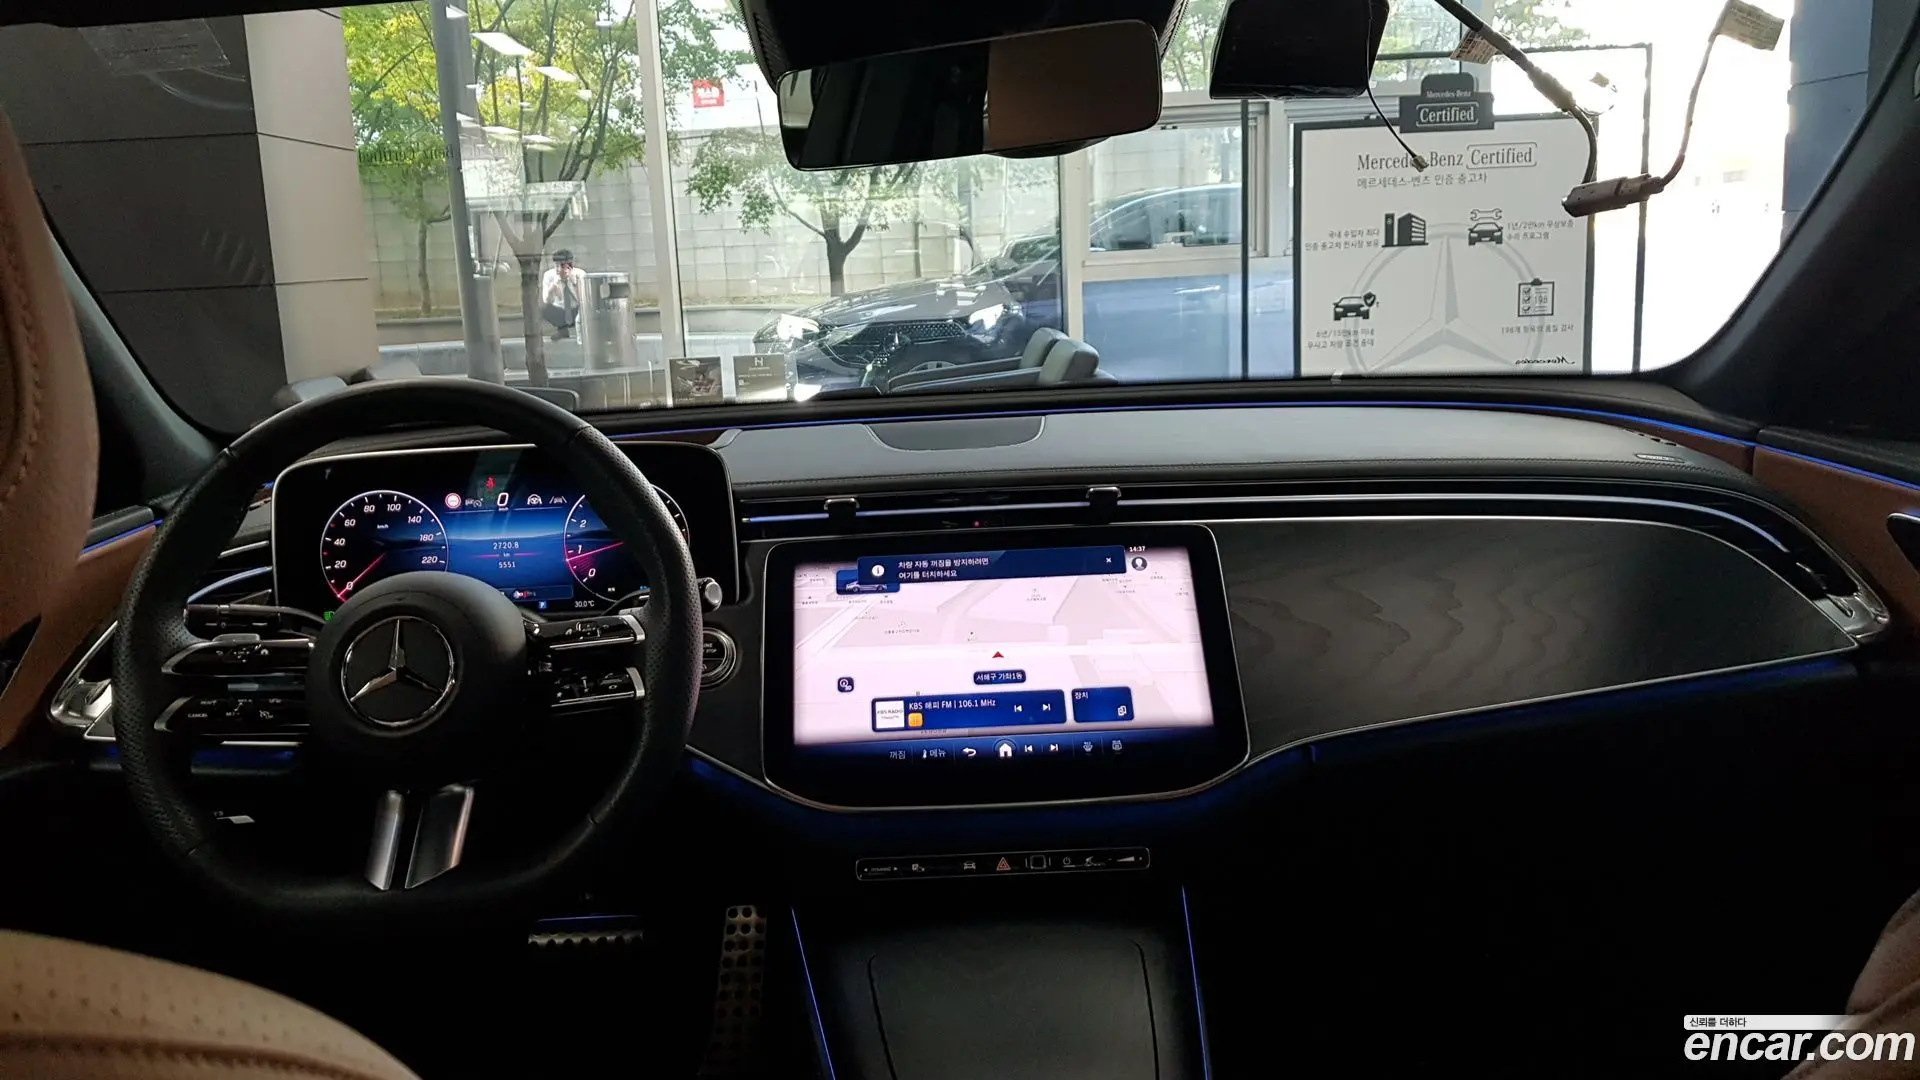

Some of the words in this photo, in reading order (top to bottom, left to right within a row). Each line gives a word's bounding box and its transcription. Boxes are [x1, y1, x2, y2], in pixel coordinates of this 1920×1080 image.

[1426, 90, 1472, 98] Mercedes-Benz
[1419, 106, 1475, 123] Certified
[1357, 151, 1464, 171] MercedBenz
[1470, 147, 1532, 165] Certified
[1357, 175, 1431, 189] 메르세데스-벤츠
[1435, 175, 1454, 186] 인증
[1458, 172, 1488, 184] 중고차
[497, 492, 509, 507] 0
[363, 504, 375, 512] 80
[387, 503, 401, 511] 100
[344, 519, 356, 527] 60
[407, 515, 422, 524] 140
[579, 519, 587, 528] 2
[419, 533, 434, 541] 180
[333, 538, 346, 546] 40
[493, 542, 520, 550] 2720.8
[577, 544, 583, 554] 1
[334, 560, 347, 568] 20
[421, 555, 438, 564] 220
[898, 561, 913, 569] 차량
[914, 560, 929, 568] 자동
[930, 559, 952, 568] 꺼짐을
[954, 557, 989, 566] 방지하려면
[498, 561, 516, 569] 5551
[588, 567, 596, 577] 0
[898, 571, 920, 580] 여기를
[921, 570, 958, 578] 터치하세요
[1074, 691, 1089, 699] 장치
[908, 702, 923, 710] KBS
[924, 701, 940, 709] 해피
[941, 701, 953, 709] FM
[958, 700, 979, 708] 106.1
[889, 750, 906, 760] 꺼짐
[930, 749, 946, 758] 메뉴
